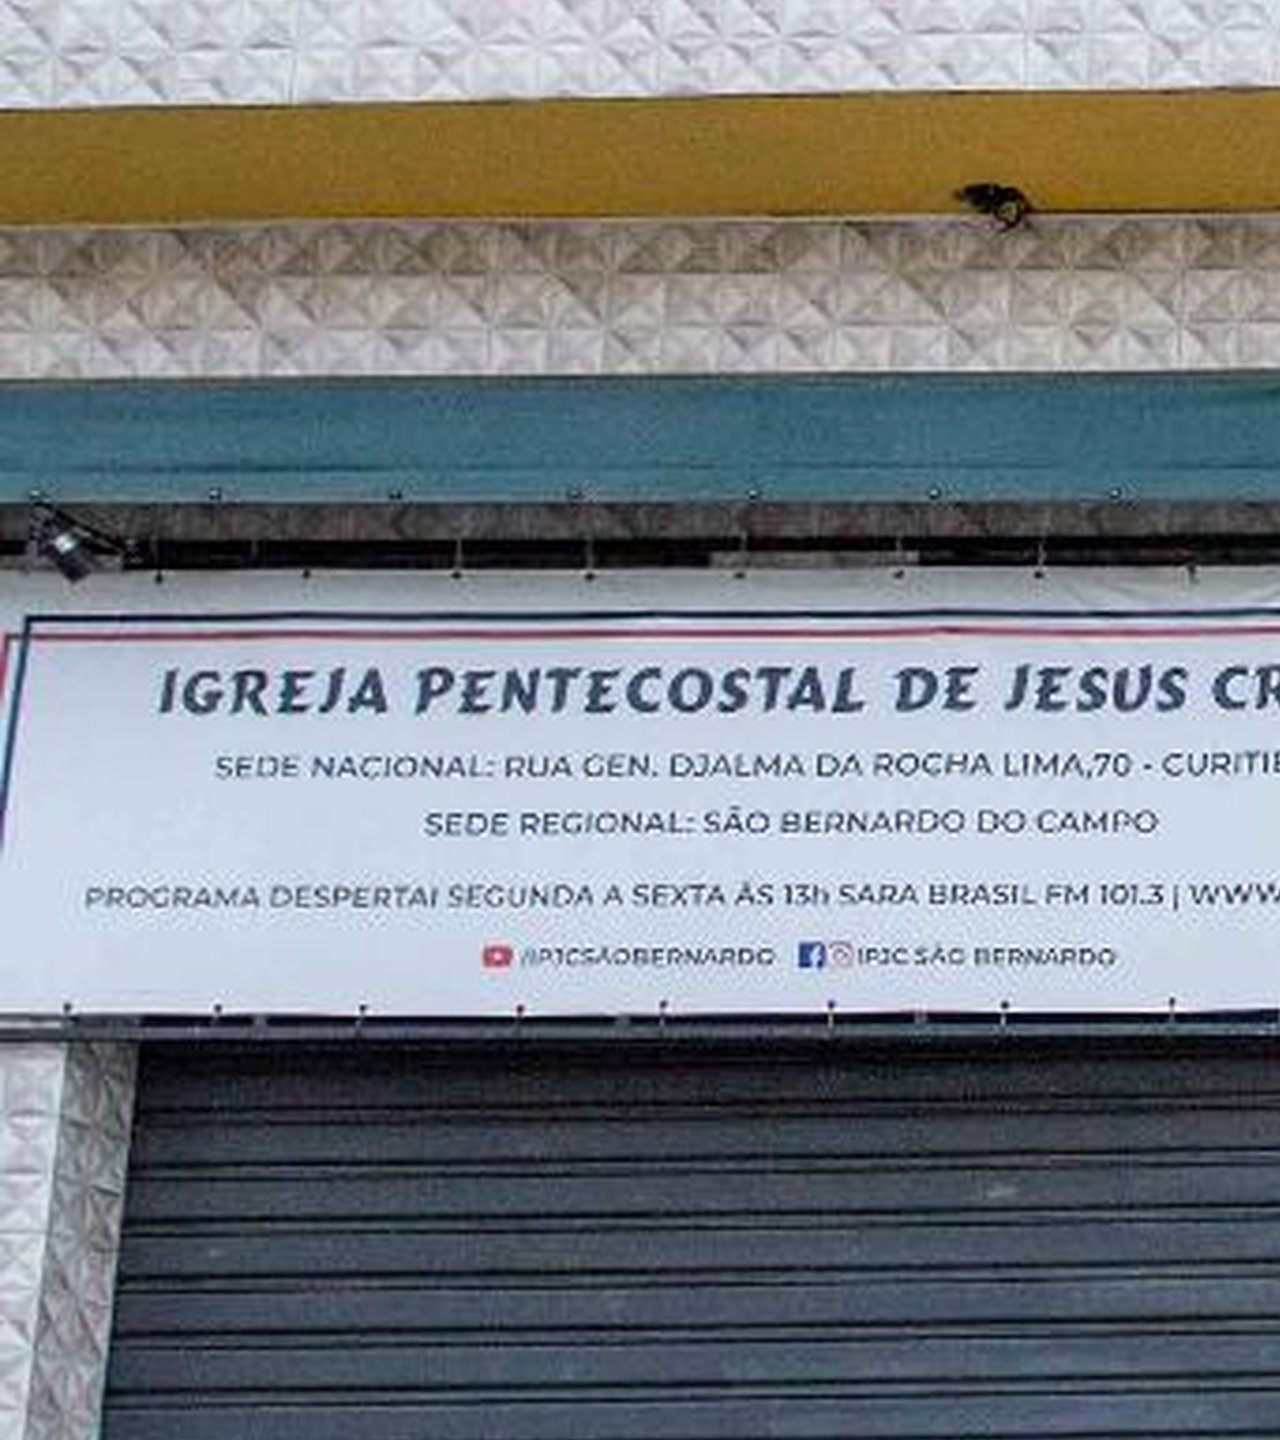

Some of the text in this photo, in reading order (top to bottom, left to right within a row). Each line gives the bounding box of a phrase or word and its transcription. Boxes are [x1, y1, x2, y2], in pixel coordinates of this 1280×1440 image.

[159, 667, 389, 715] IGREJA
[414, 666, 865, 715] PENTECOSTAL
[893, 666, 979, 712] DE
[1003, 664, 1188, 712] JESUS
[215, 756, 299, 780] SEDE
[311, 756, 494, 779] NACIONAL:
[504, 755, 572, 778] RUA
[583, 754, 659, 777] GEN.
[669, 753, 805, 777] DJALMA
[816, 753, 864, 777] DA
[874, 752, 992, 777] ROCHA
[1003, 752, 1131, 780] LIMA,70
[424, 805, 1160, 837] SEDE REGIONAL: SÃO BERNARDO DO CAMPO
[85, 886, 260, 909] PROGRAMA
[269, 885, 439, 908] DESPERTAI
[449, 884, 594, 908] SEGUNDA
[602, 885, 624, 906] A
[631, 884, 726, 906] SEXTA
[784, 883, 830, 905] 13h
[838, 883, 920, 906] SARA
[928, 883, 1037, 905] BRASIL
[1045, 883, 1090, 904] FM
[1100, 883, 1165, 904] 101.3
[974, 946, 1117, 967] BERNARDO
